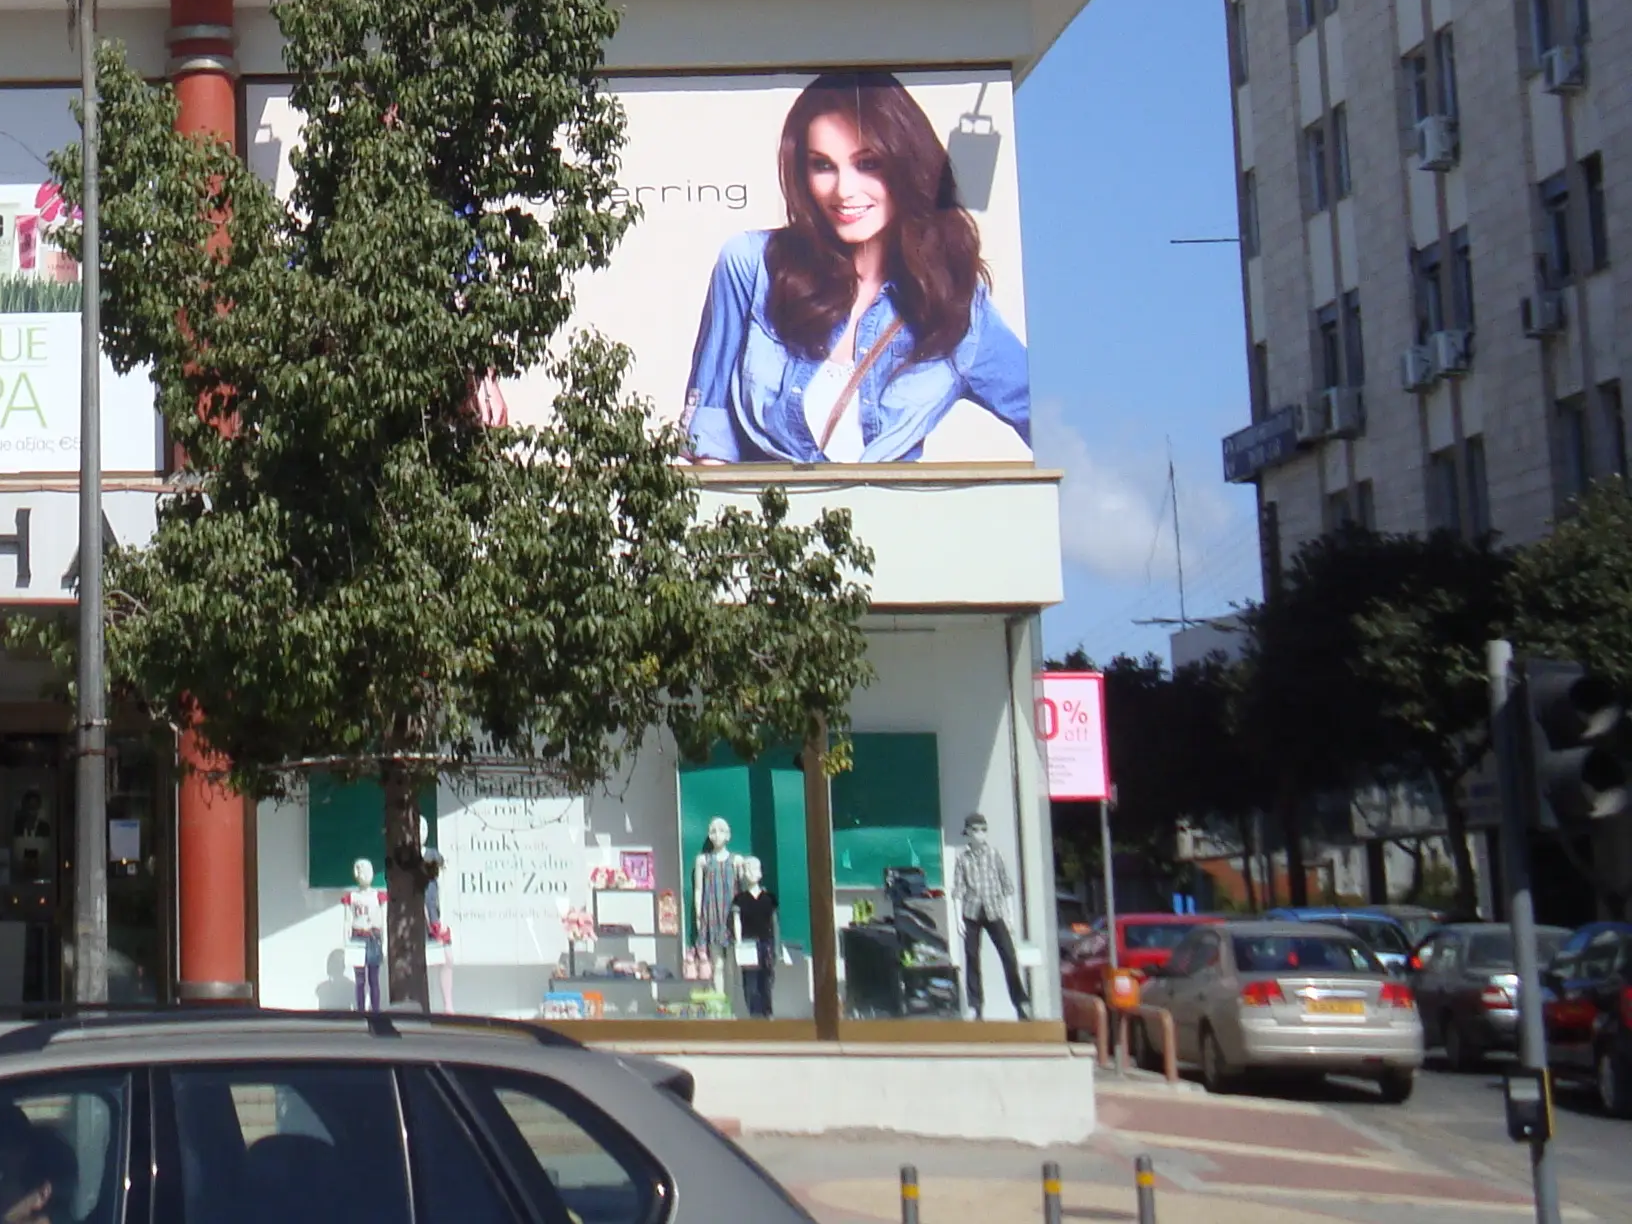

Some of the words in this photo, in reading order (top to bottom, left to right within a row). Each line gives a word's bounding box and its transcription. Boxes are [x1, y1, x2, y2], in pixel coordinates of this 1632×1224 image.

[608, 179, 748, 210] erring
[470, 833, 520, 853] funky
[461, 872, 514, 894] Blue
[522, 872, 568, 894] Zoo
